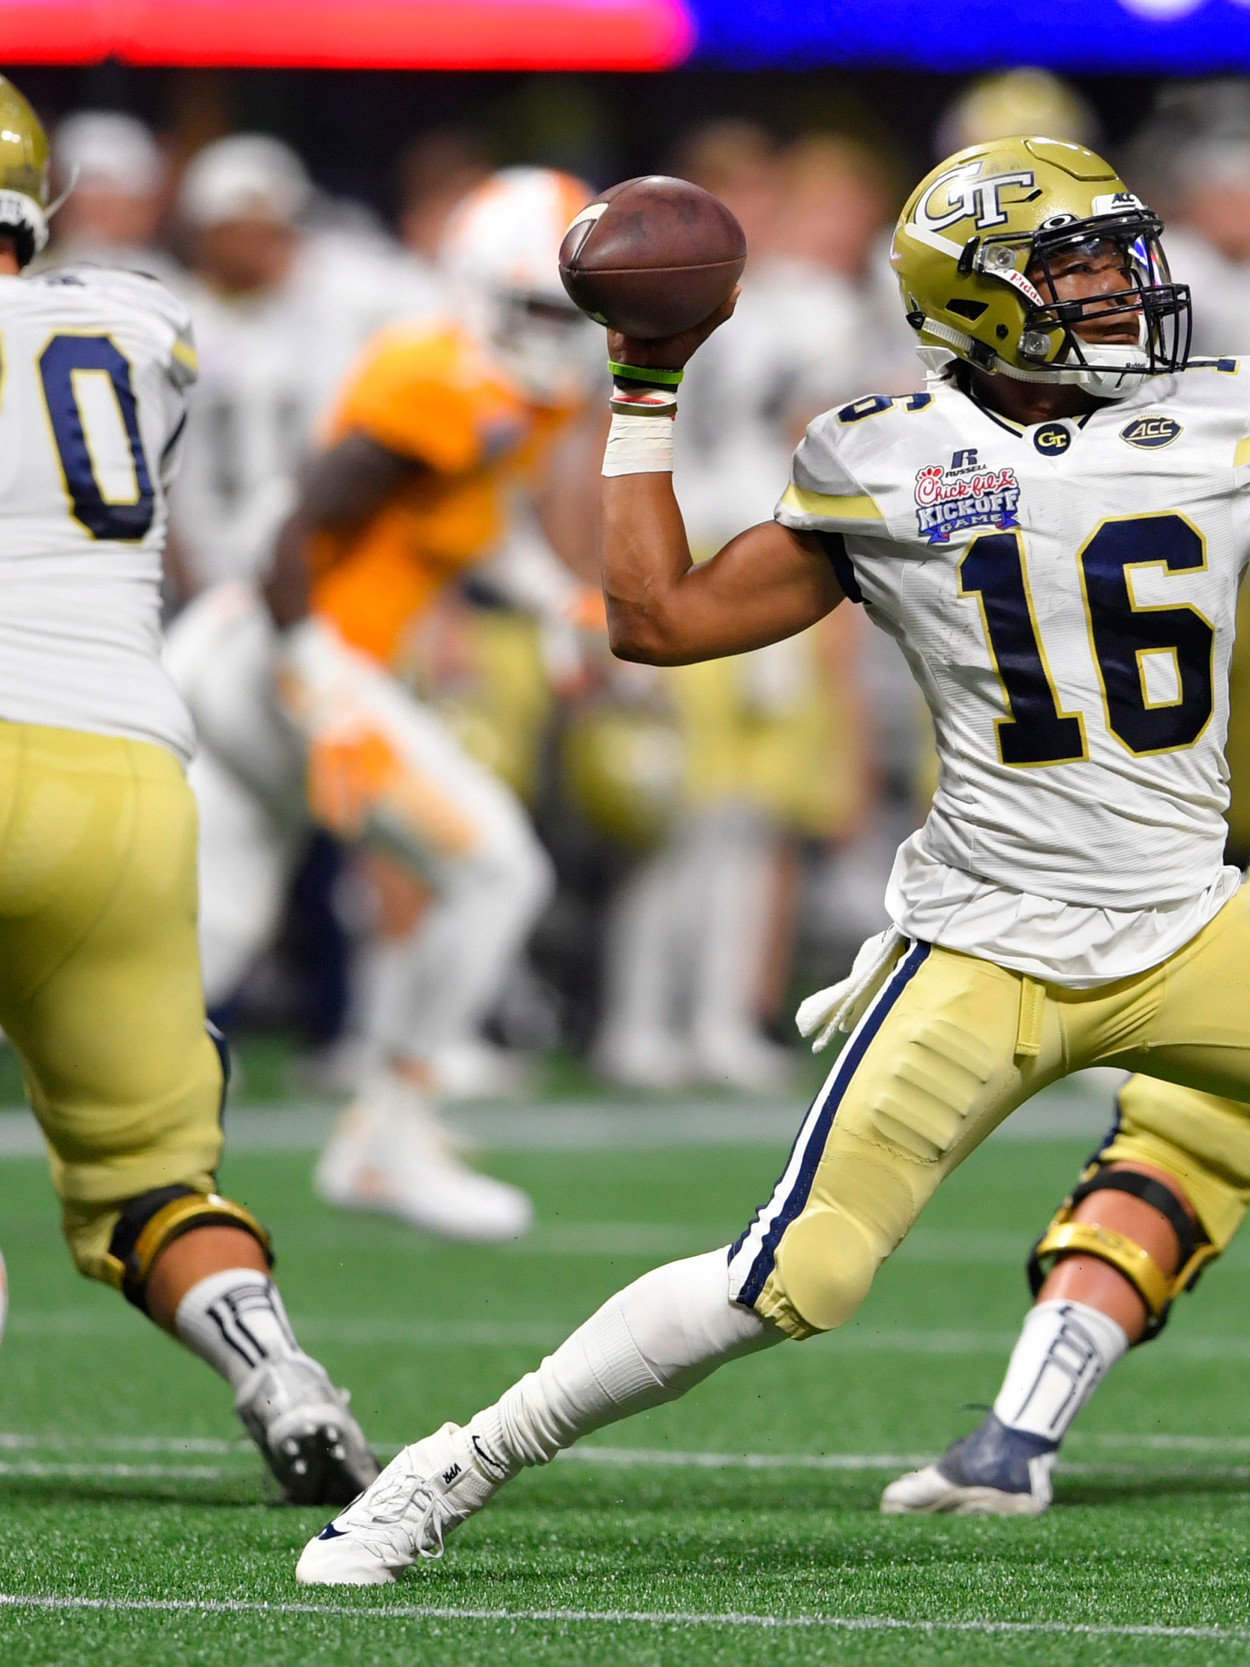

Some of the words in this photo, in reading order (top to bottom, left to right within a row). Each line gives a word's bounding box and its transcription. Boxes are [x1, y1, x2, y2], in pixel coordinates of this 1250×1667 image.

[914, 160, 1036, 232] GT
[0, 326, 155, 543] 0
[1037, 430, 1068, 448] GT
[1128, 420, 1175, 437] ACC
[945, 464, 988, 478] RUSSELL
[918, 488, 1019, 532] KICKOFF
[940, 513, 1002, 533] GAME
[956, 510, 1216, 768] 16
